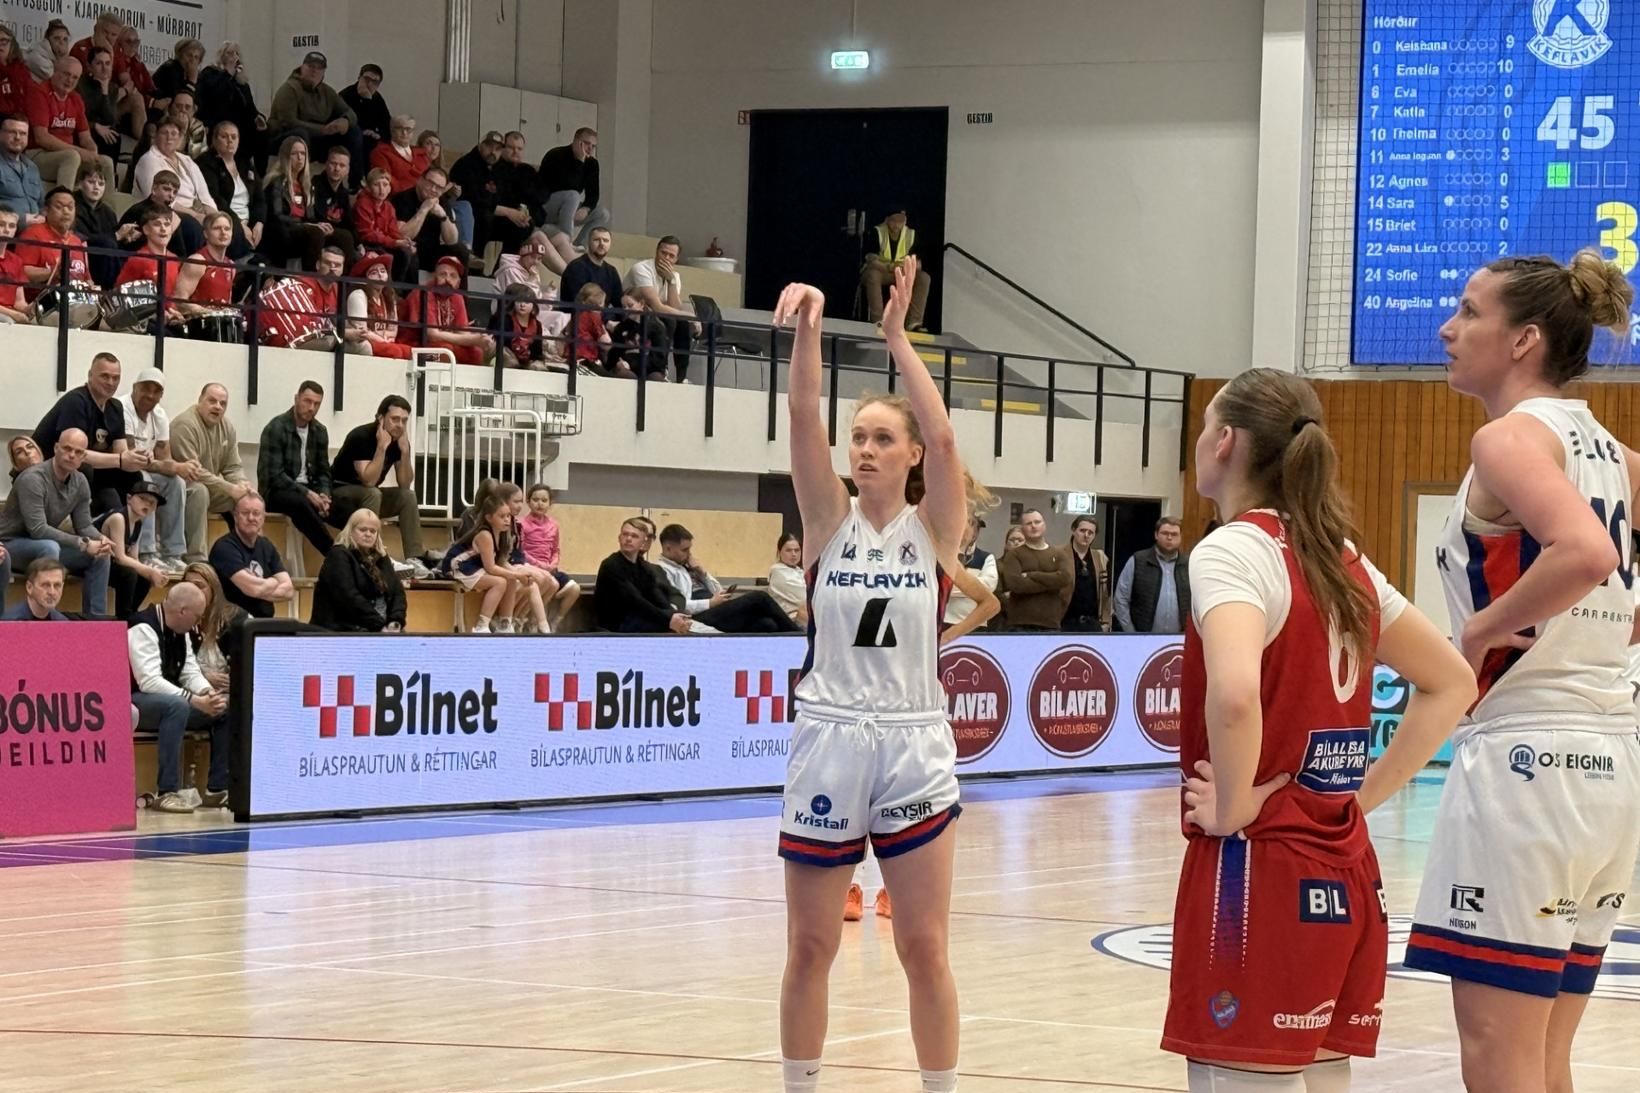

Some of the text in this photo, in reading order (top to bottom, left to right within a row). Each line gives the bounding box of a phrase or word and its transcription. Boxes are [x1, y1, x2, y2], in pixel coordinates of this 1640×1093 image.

[1505, 35, 1515, 48] 9
[1372, 64, 1380, 78] 1
[1497, 60, 1514, 73] 10
[1394, 86, 1418, 98] Eva
[1504, 85, 1514, 98] 0
[1370, 104, 1380, 120] 7
[1503, 106, 1513, 119] 0
[1536, 95, 1616, 150] 45
[1370, 128, 1387, 142] 10
[1502, 127, 1511, 141] 0
[1370, 149, 1384, 164] 11
[1500, 148, 1510, 161] 3
[1369, 174, 1385, 189] 12
[1500, 173, 1508, 186] 0
[1368, 195, 1509, 210] 14 Sara 5
[1367, 218, 1384, 232] 15
[1500, 218, 1508, 231] 0
[1596, 201, 1640, 276] 3
[1366, 242, 1383, 256] 22
[1365, 268, 1382, 282] 24
[1364, 295, 1381, 309] 40
[374, 670, 498, 736] Bílnet
[595, 668, 702, 730] Bílnet
[1039, 685, 1107, 719] BÍLAVER
[8, 741, 107, 767] EILDIN
[299, 747, 497, 777] BÍLASPRAUTUN & RÉTTINGAR
[530, 740, 701, 768] BÍLASPRAUTUN & RÉTTINGAR
[794, 810, 849, 831] Kristall
